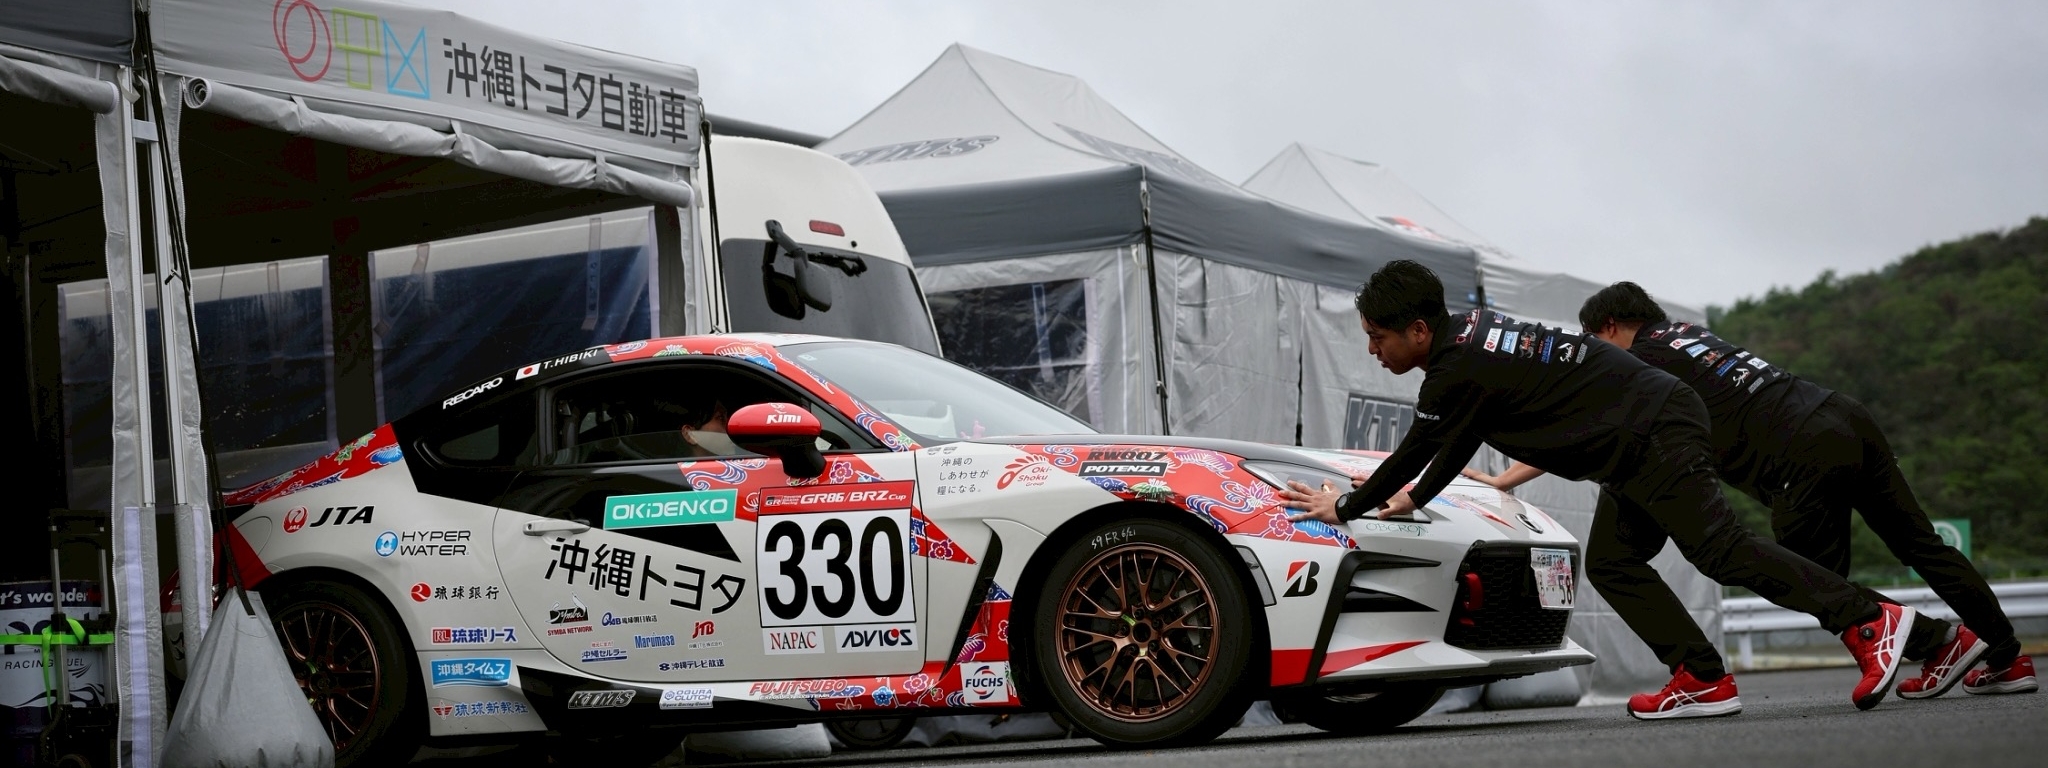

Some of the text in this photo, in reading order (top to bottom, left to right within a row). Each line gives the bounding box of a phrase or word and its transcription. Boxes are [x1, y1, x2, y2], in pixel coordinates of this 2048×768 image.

[442, 37, 689, 144] 沖縄トヨタ自動車
[543, 349, 598, 370] T.HIBIKI
[442, 377, 504, 410] RECARO
[941, 457, 973, 467] 沖縄の
[1084, 465, 1160, 473] POTENZA
[939, 469, 989, 481] しあわせが
[888, 493, 906, 501] Cup
[309, 506, 375, 528] JTA
[401, 530, 471, 542] HYPER
[1105, 531, 1120, 545] FR
[400, 545, 467, 556] WATER
[763, 516, 905, 620] 330
[545, 537, 746, 615] 沖縄トヨタ
[434, 586, 500, 600] 琉球銀行
[452, 629, 517, 643] 琉球リース
[547, 625, 593, 636] SYMBA NETWORK
[635, 634, 675, 648] Marumasa
[769, 631, 817, 651] NAPAC
[841, 628, 913, 648] ADVICS
[582, 649, 627, 659] 沖縄セルラー
[66, 658, 85, 667] UEL
[437, 662, 506, 677] 沖縄タイムス
[671, 659, 725, 670] 沖縄テレビ放送
[749, 679, 848, 695] FUJITSUBO
[965, 677, 1004, 688] FUCHS
[568, 690, 637, 710] KTMS
[454, 702, 529, 717] 琉球新報社
